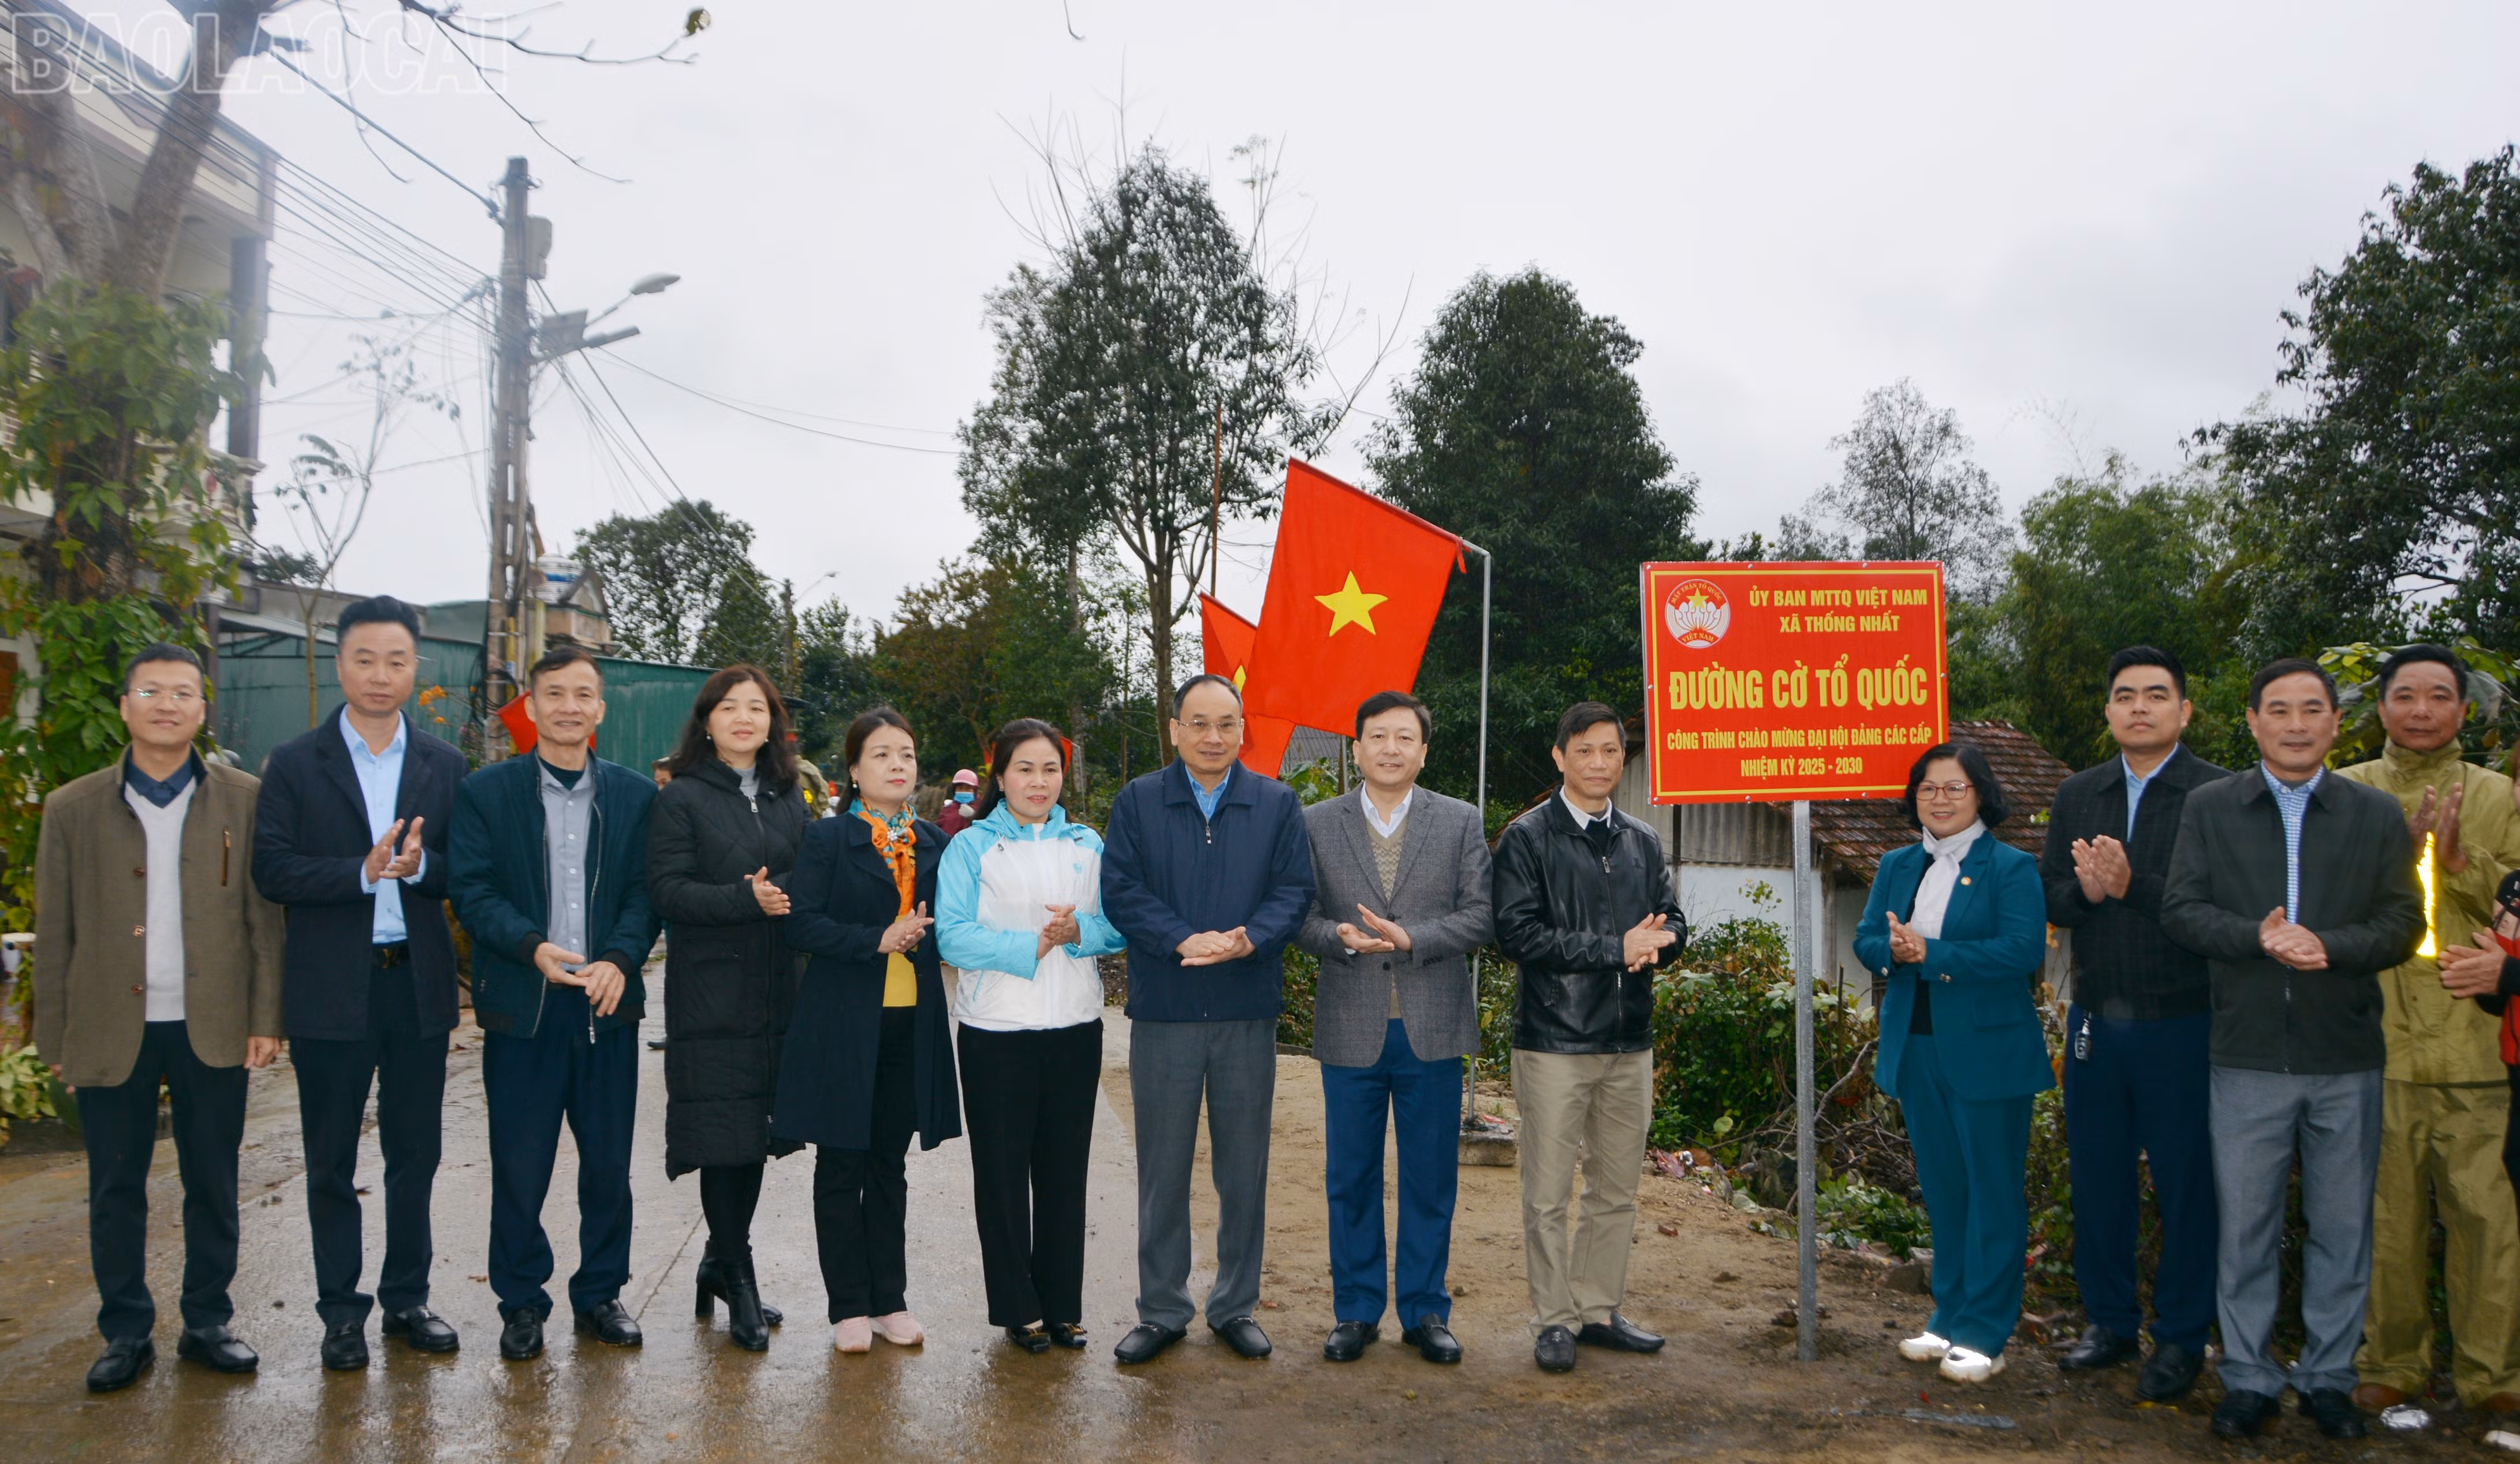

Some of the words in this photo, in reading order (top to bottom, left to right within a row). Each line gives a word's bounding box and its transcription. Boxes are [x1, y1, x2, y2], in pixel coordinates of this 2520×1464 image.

[1749, 585, 1770, 607] ỦY
[1774, 589, 1806, 607] BAN
[1811, 589, 1851, 607] MTTQ
[1855, 587, 1888, 609] VIỆT
[1892, 589, 1928, 605] NAM
[1780, 613, 1801, 633] XÃ
[1805, 611, 1855, 633] THỐNG
[1859, 611, 1900, 632] NHẤT
[1669, 661, 1764, 710] ĐƯỜNG
[1772, 660, 1809, 708] CỜ
[1815, 653, 1849, 707] TỔ
[1857, 654, 1928, 711] QUỐC
[1667, 729, 1699, 750] CÔNG
[1702, 728, 1735, 749] TRÌNH
[1738, 727, 1768, 748] CHÀO
[1771, 727, 1806, 748] MỪNG
[1808, 729, 1827, 750] ĐẠI
[1829, 726, 1848, 749] HỘI
[1851, 723, 1882, 746] ĐẢNG
[1884, 724, 1907, 745] CÁC
[1909, 721, 1932, 745] CẤP
[1740, 756, 1778, 779] NHIỆM
[1780, 755, 1795, 776] KỲ
[1798, 757, 1825, 775] 2025
[1835, 757, 1863, 775] 2030
